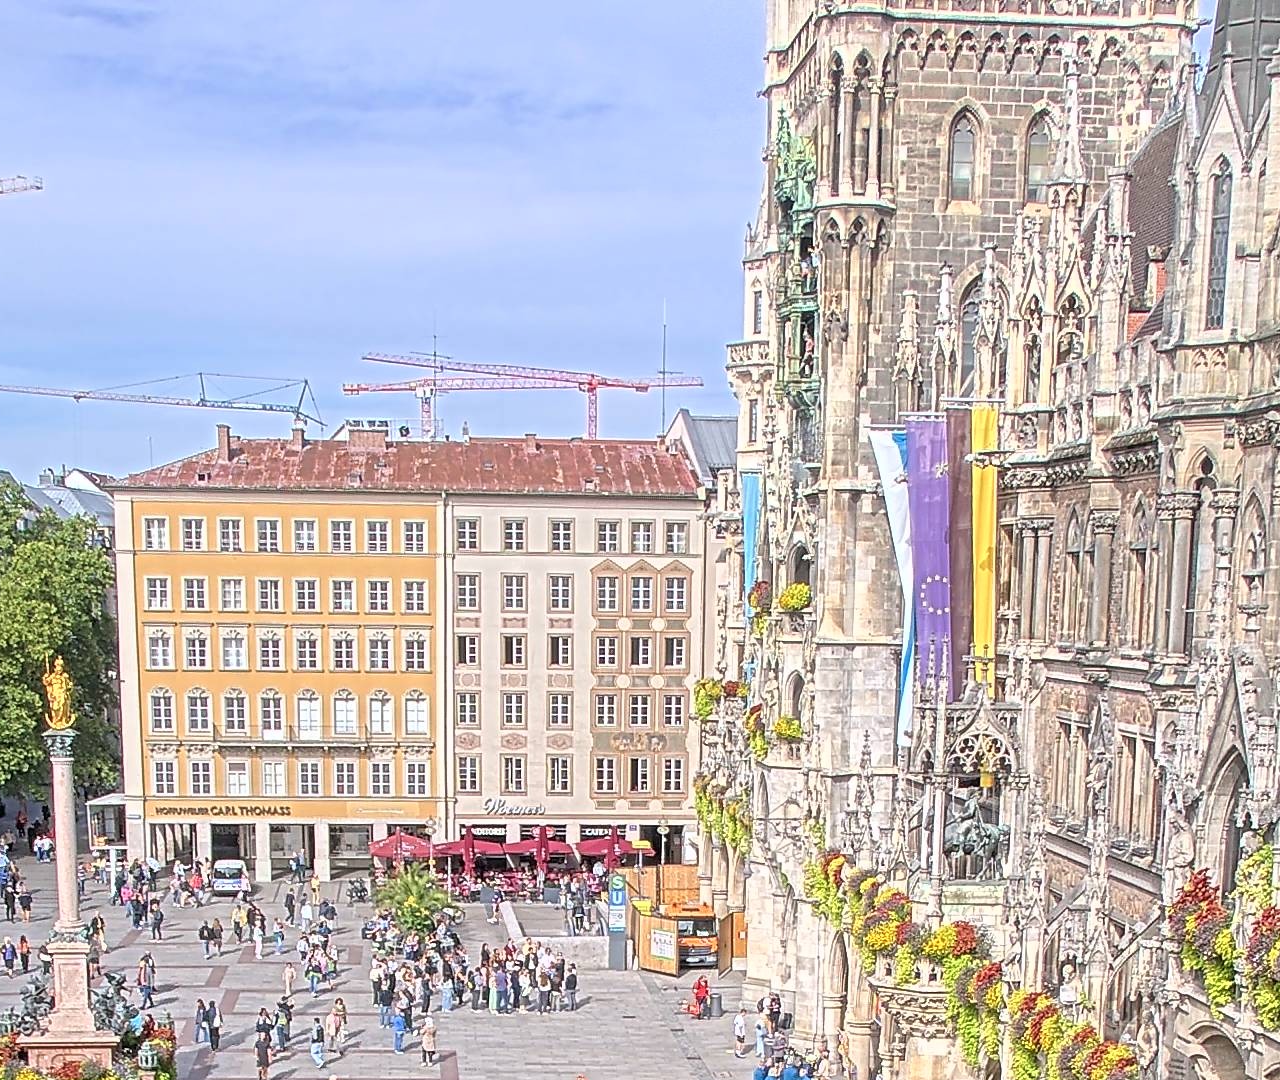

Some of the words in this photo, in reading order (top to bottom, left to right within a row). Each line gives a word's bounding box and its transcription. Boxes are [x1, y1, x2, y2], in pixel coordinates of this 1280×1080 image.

[210, 805, 238, 816] CARL
[239, 806, 292, 816] THOMASS
[612, 875, 624, 890] S
[612, 891, 623, 905] U
